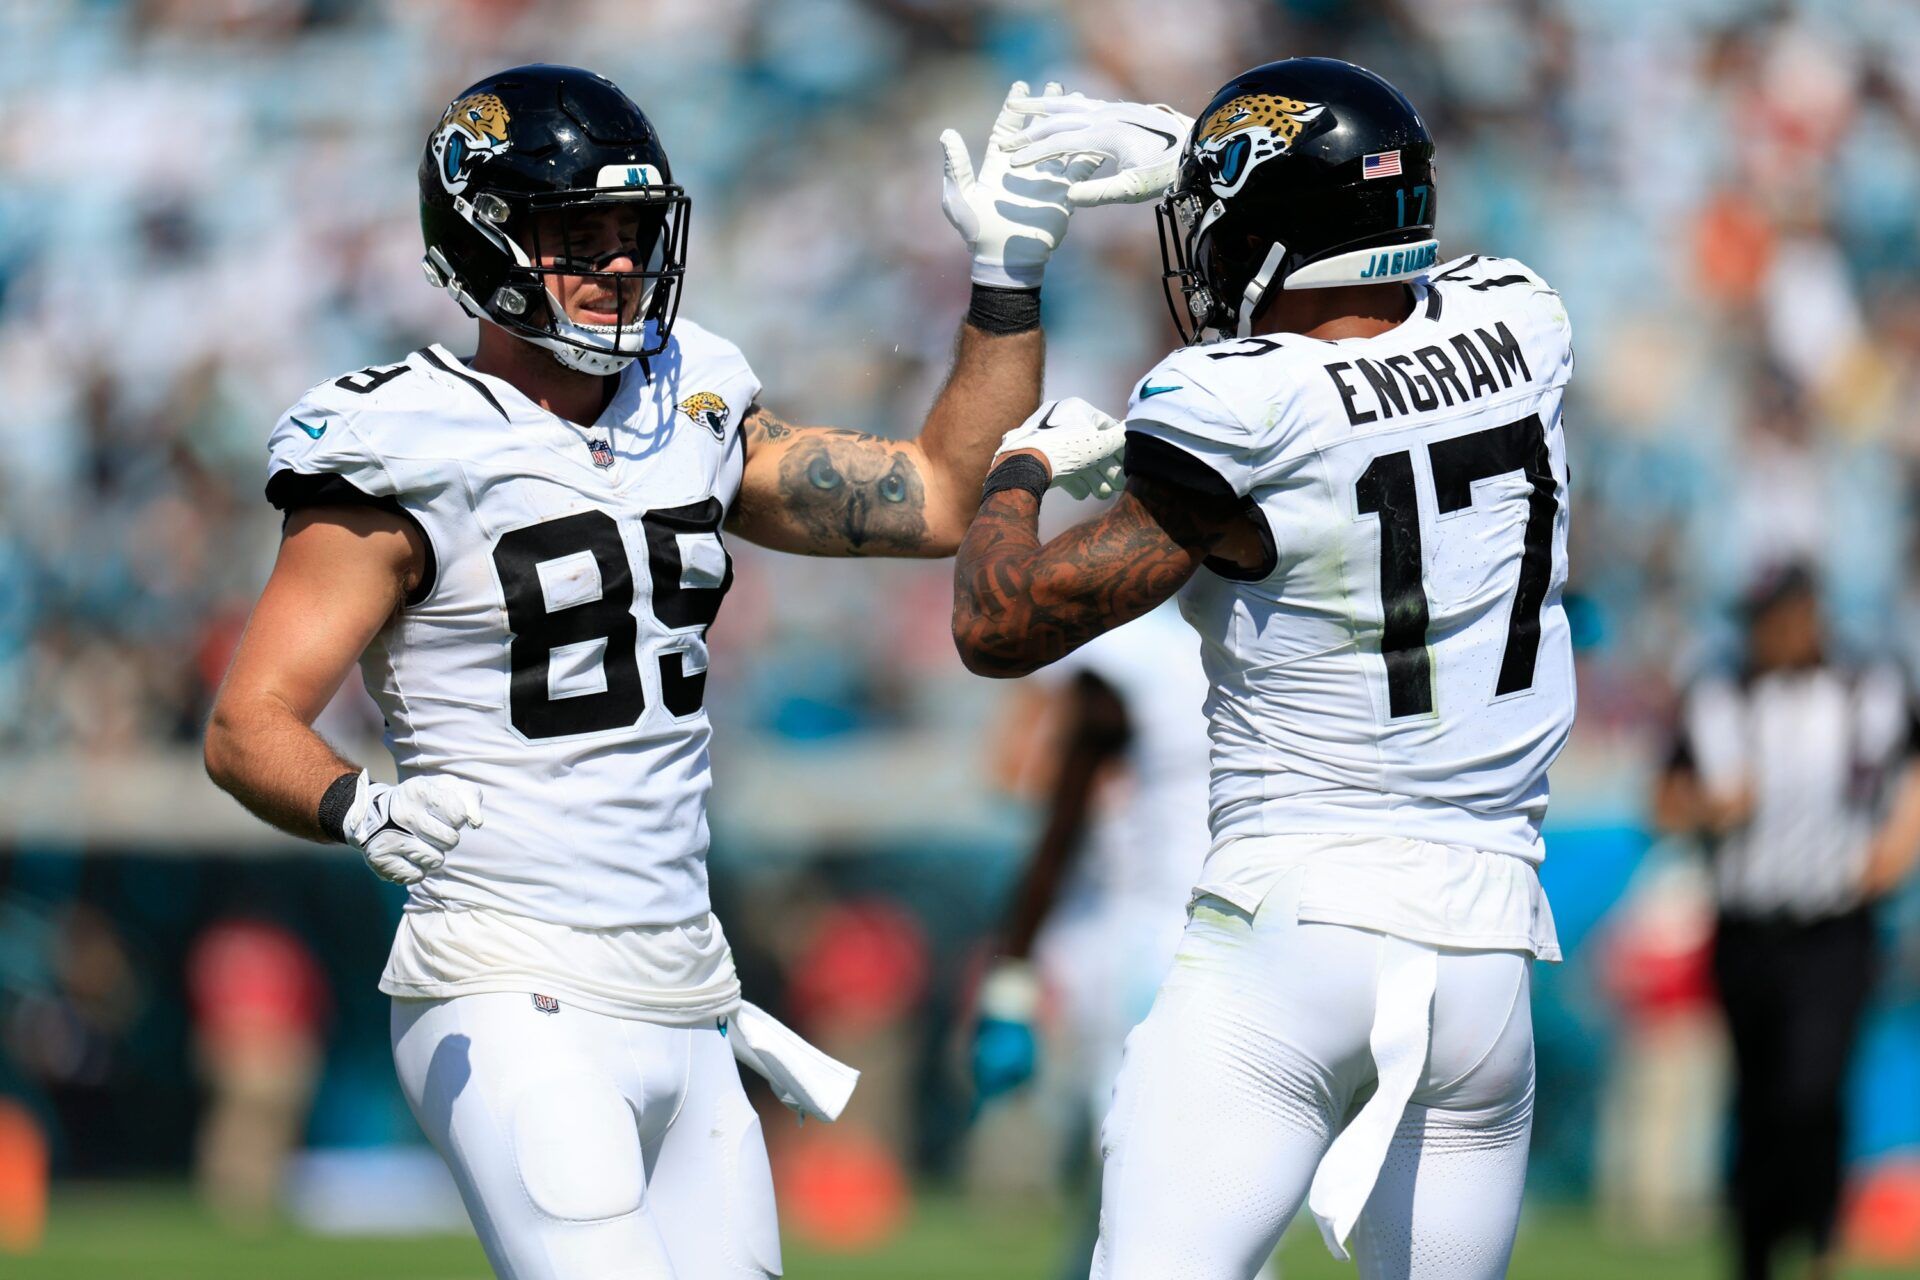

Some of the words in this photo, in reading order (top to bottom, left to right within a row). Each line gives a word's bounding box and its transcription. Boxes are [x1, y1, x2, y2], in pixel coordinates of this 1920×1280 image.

[1396, 185, 1427, 228] 17
[1323, 321, 1533, 426] ENGRAM
[492, 496, 735, 740] 89
[1356, 412, 1558, 718] 17
